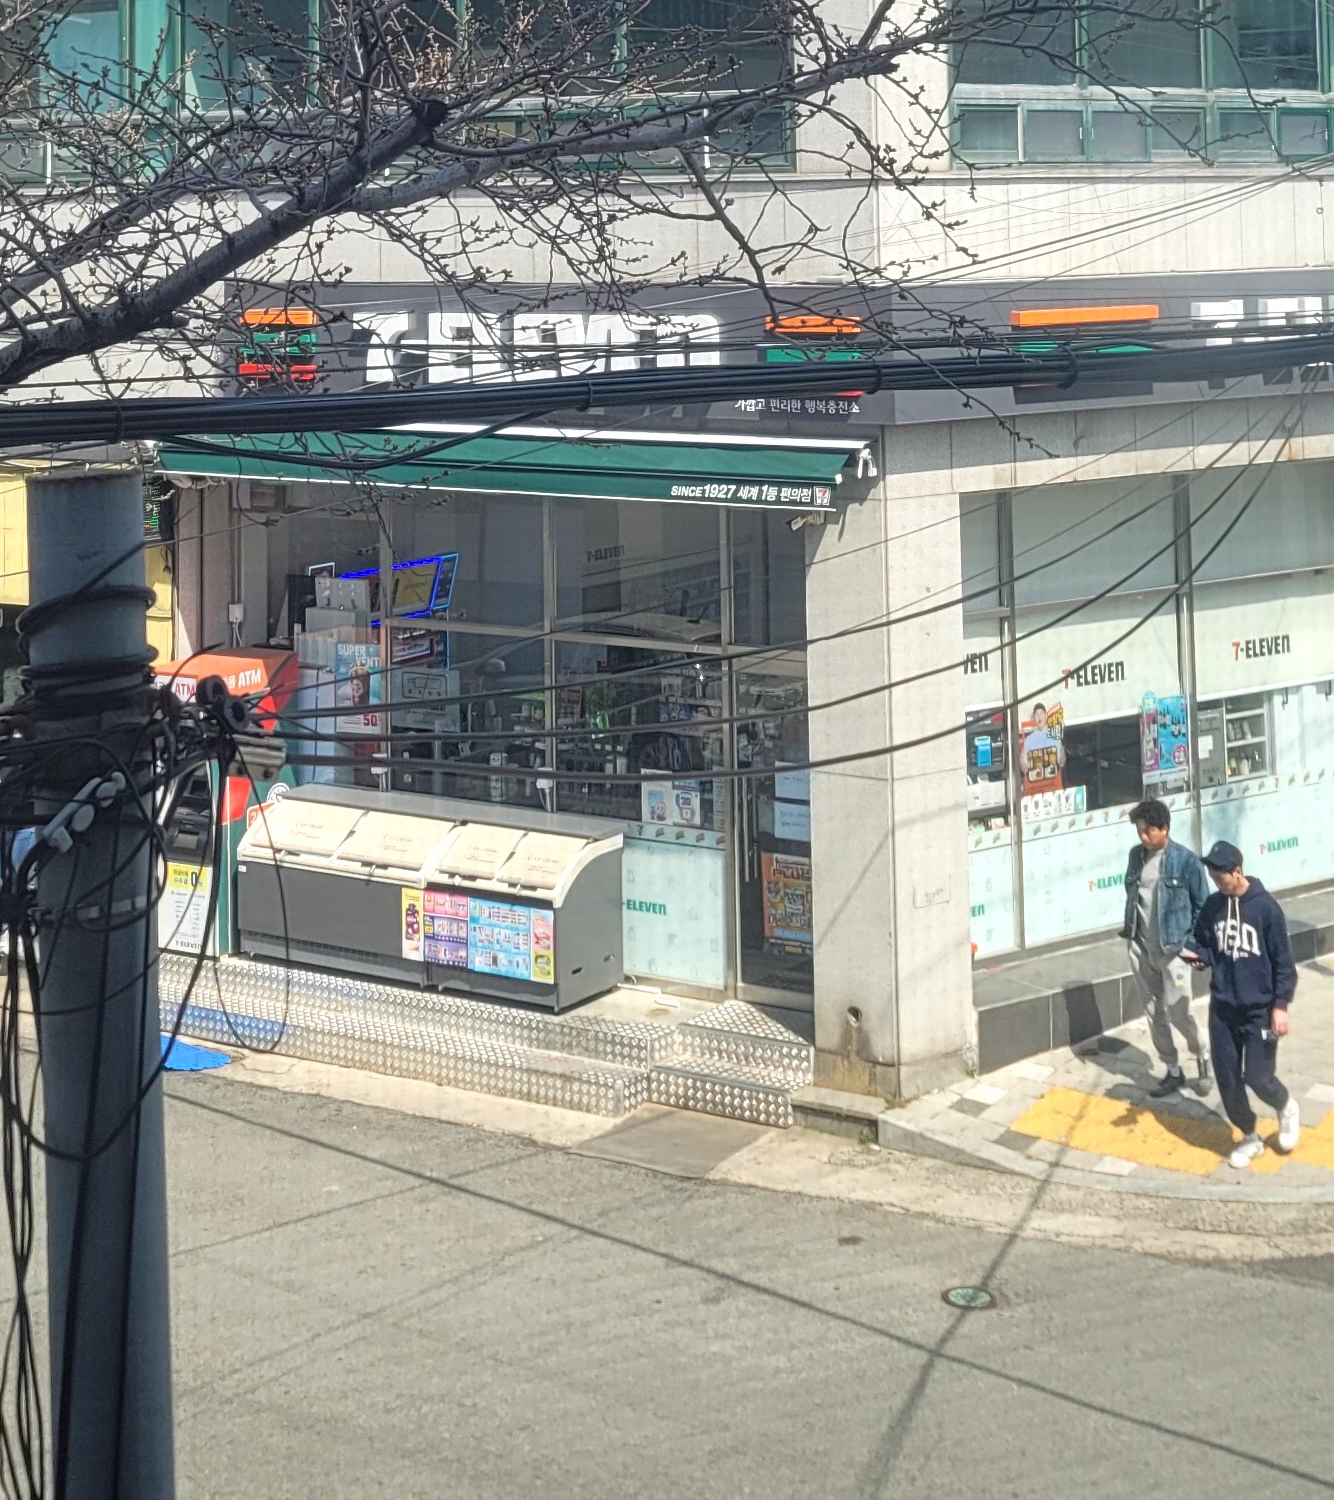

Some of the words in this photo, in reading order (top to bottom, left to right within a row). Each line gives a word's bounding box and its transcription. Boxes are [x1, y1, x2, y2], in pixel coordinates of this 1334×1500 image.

[734, 399, 766, 412] 가깝고
[769, 399, 802, 413] 편리한
[805, 399, 861, 414] 행복충전소
[671, 485, 703, 497] SINCE
[703, 483, 736, 499] 1927
[737, 486, 758, 500] 세계
[760, 484, 778, 501] 1등
[779, 487, 812, 503] 편의점
[337, 644, 366, 656] SUPER
[238, 668, 262, 688] ATM
[174, 683, 196, 696] ATM
[1087, 873, 1125, 893] 7-ELEVE
